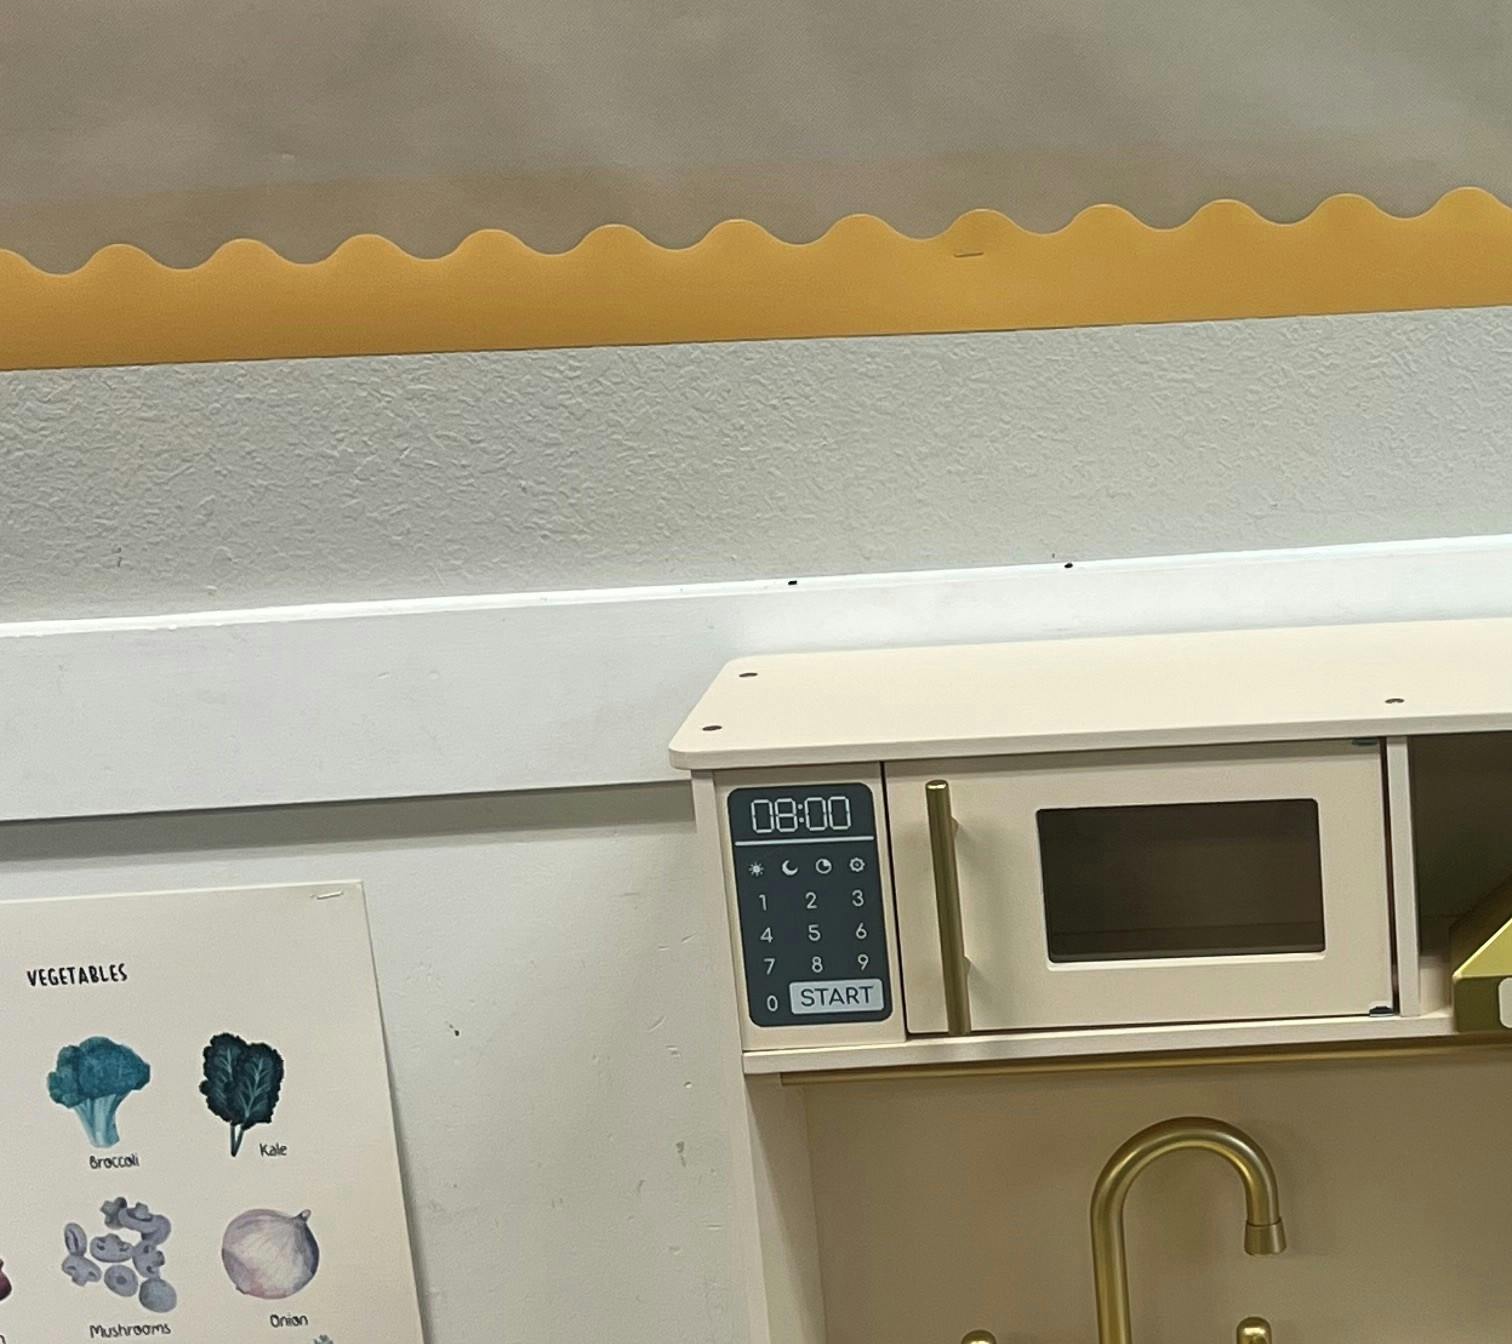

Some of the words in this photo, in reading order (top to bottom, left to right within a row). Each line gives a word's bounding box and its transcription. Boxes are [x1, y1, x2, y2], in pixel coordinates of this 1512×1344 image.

[751, 796, 851, 834] 08:00
[759, 894, 767, 911] 1
[805, 892, 817, 909] 2
[852, 889, 864, 906] 3
[760, 927, 773, 943] 4
[808, 924, 821, 941] 5
[856, 922, 867, 940] 6
[26, 963, 128, 987] VEGETABLES
[764, 958, 775, 975] 7
[812, 956, 823, 973] 8
[858, 954, 869, 970] 9
[767, 995, 778, 1012] 0
[801, 986, 873, 1007] START
[260, 1143, 287, 1157] Kale
[89, 1154, 140, 1169] Broccoli
[90, 1322, 171, 1339] Mushrooms
[270, 1313, 308, 1327] Onion
